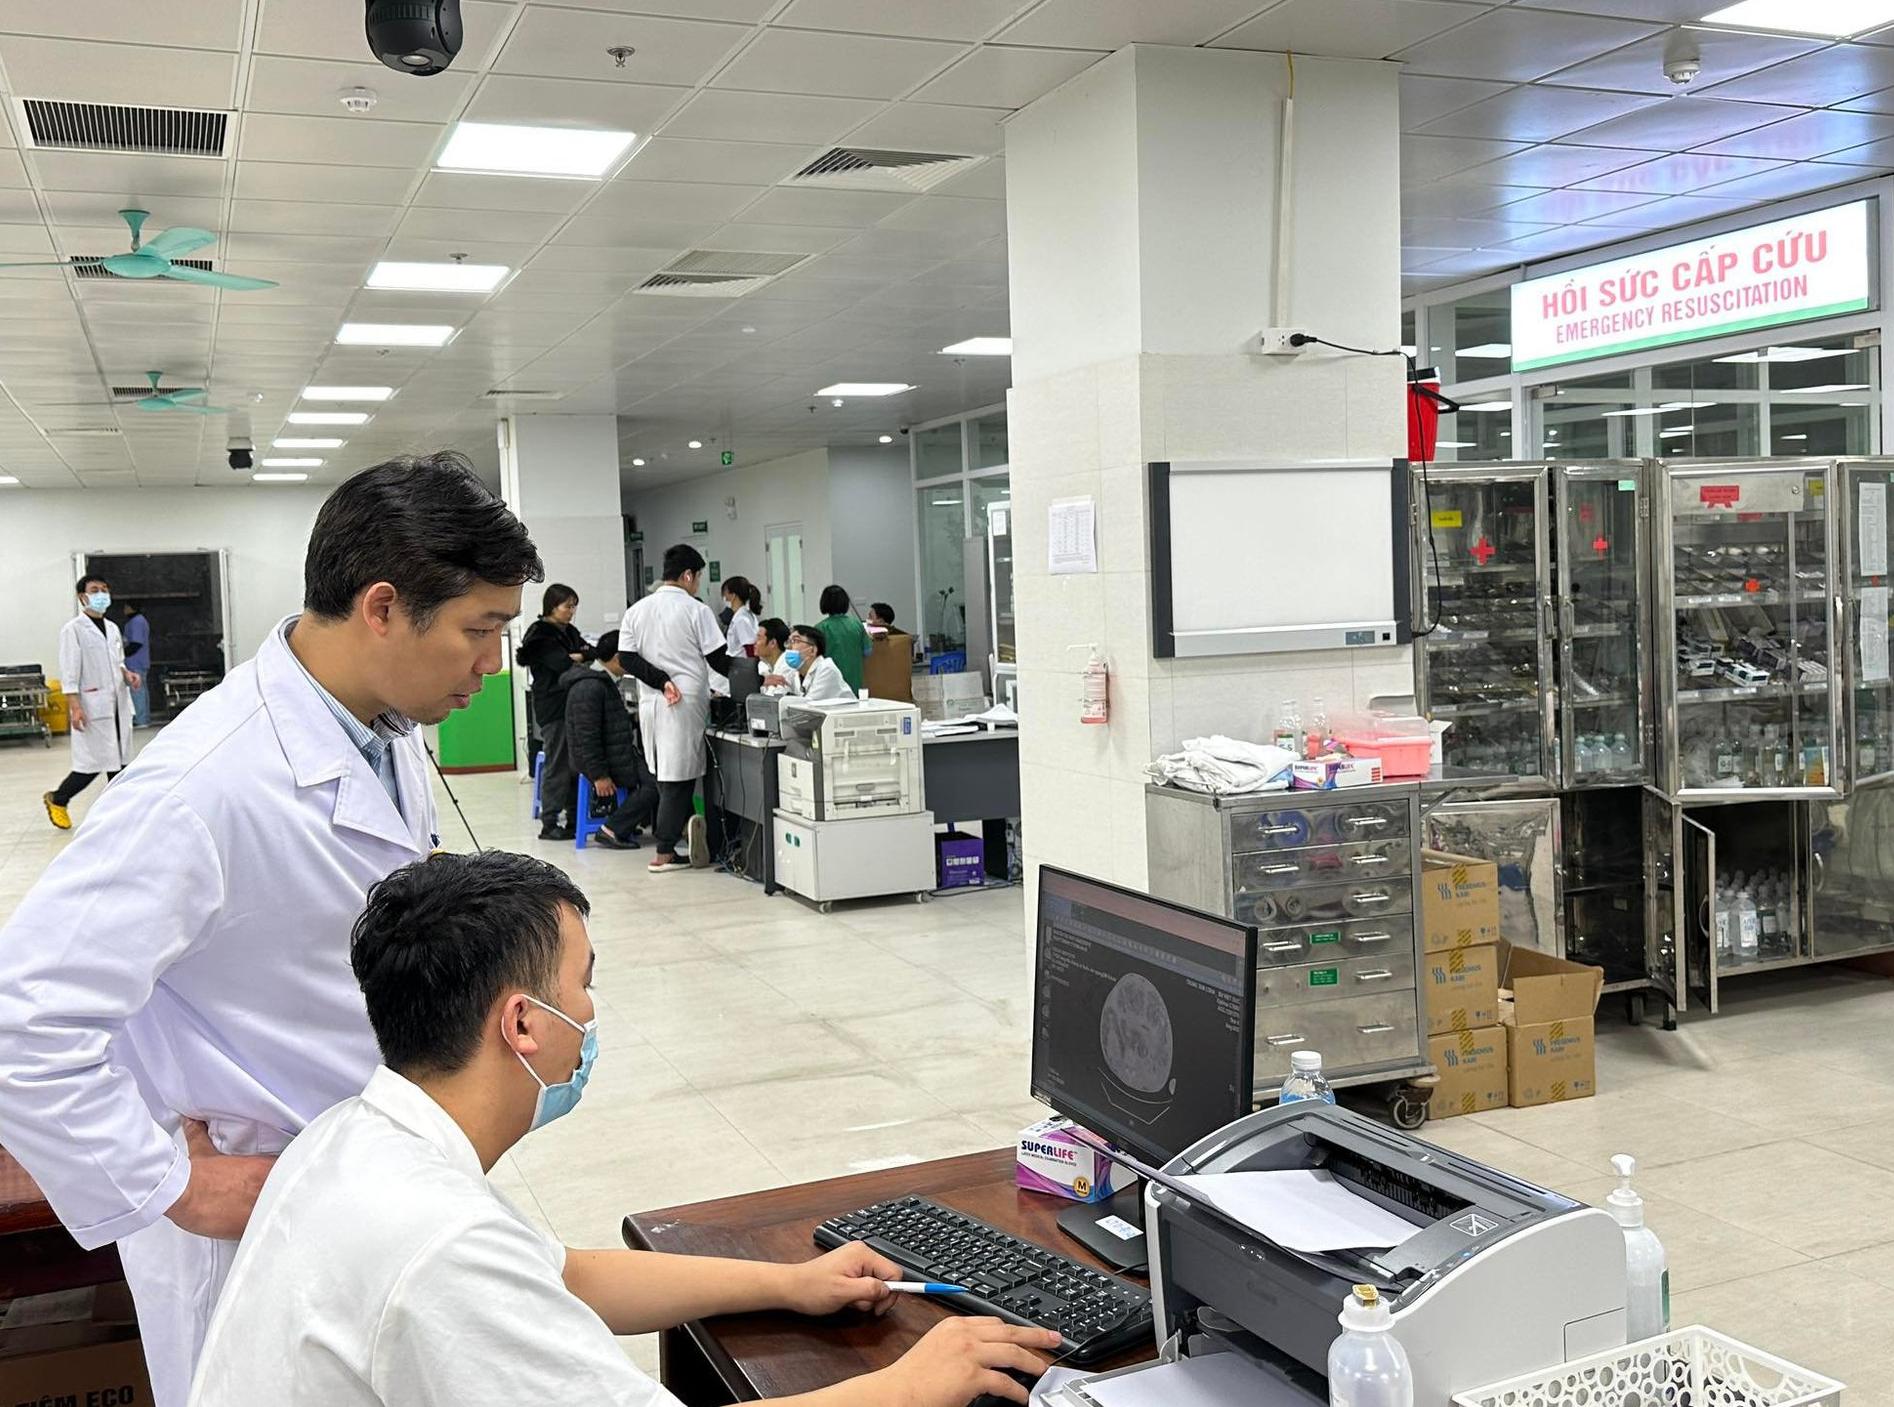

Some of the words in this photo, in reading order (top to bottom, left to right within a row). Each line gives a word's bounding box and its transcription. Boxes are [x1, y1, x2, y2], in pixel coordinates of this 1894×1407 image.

[1542, 277, 1588, 320] HỒI
[1598, 268, 1660, 308] SỨC
[1671, 244, 1739, 292] CẤP
[1752, 229, 1828, 275] CỨU
[1556, 305, 1655, 344] EMERGENCY
[1661, 274, 1808, 323] RESUSCITATION
[1021, 1140, 1074, 1161] SUPERLIFE
[1077, 1180, 1087, 1190] M
[86, 1385, 135, 1407] ECO
